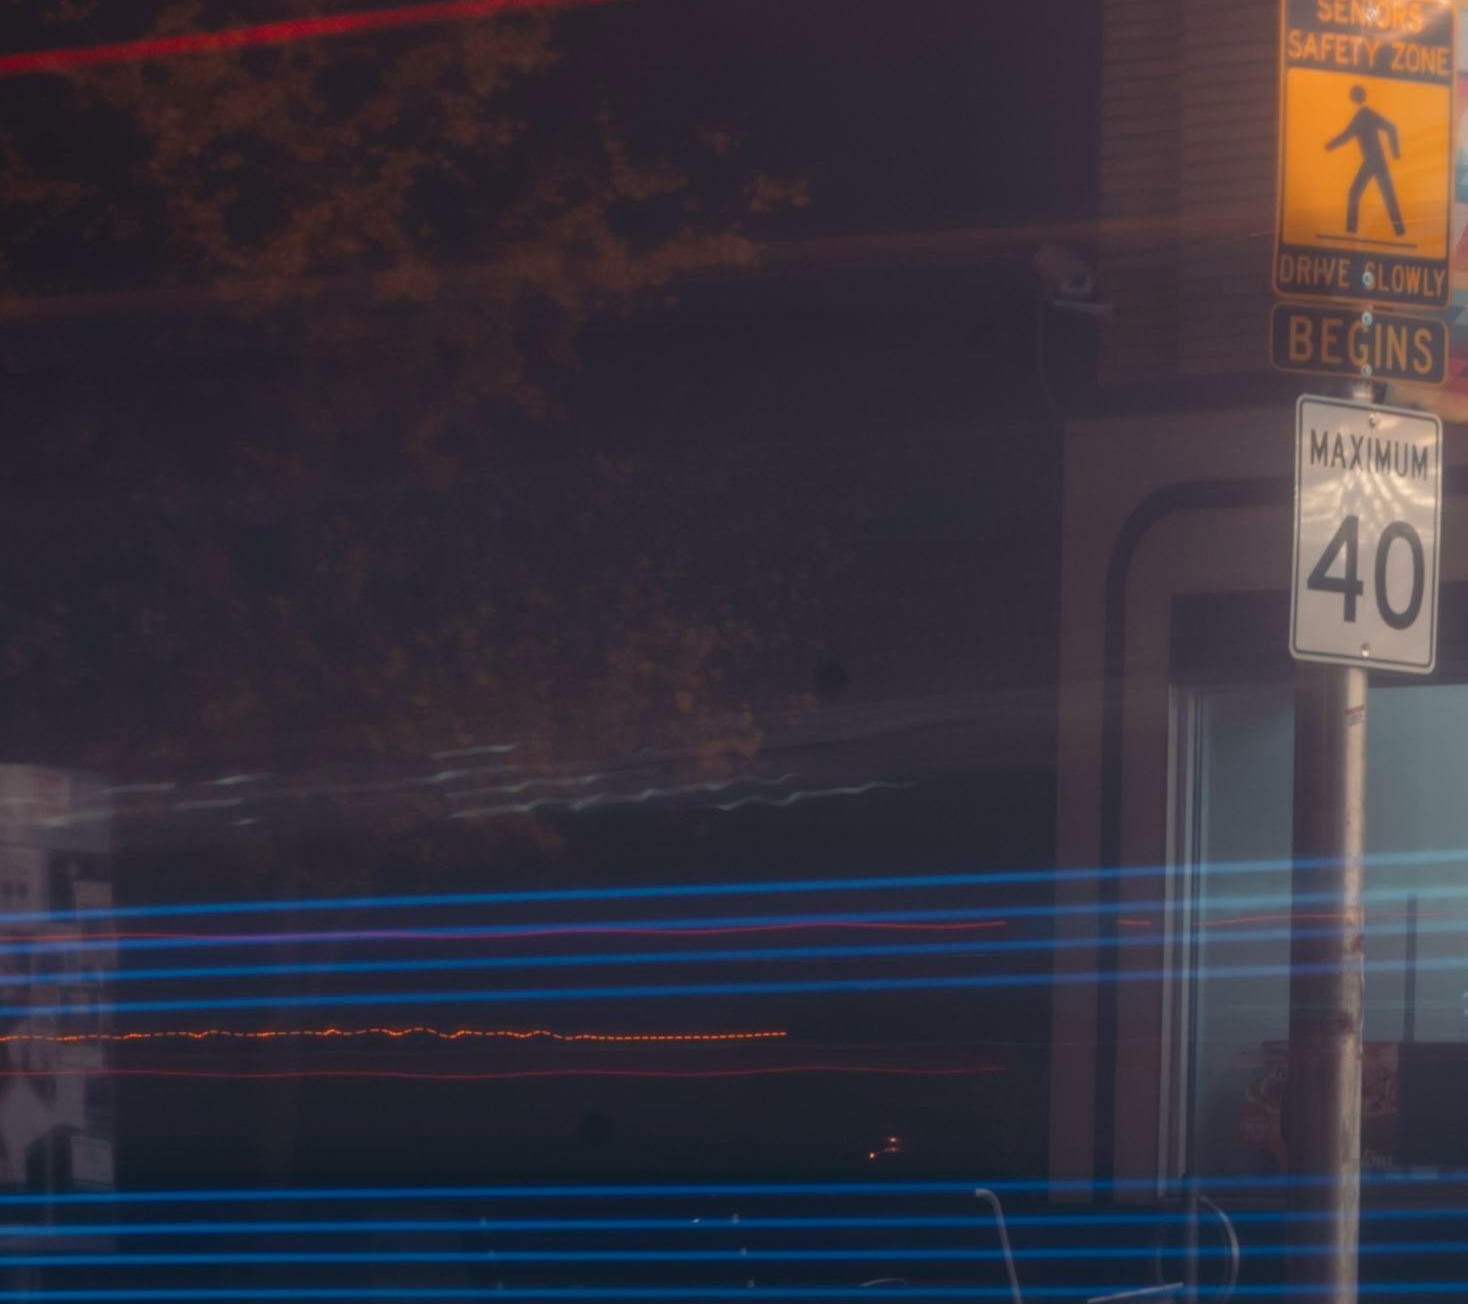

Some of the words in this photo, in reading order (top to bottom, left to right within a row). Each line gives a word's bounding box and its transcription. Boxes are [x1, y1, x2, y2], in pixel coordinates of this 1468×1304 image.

[1288, 29, 1380, 68] SAFETY
[1391, 41, 1448, 76] ZONE
[1280, 253, 1350, 289] DRIVE
[1364, 260, 1446, 297] SLOWLY
[1288, 314, 1433, 375] BEGINS
[1310, 428, 1428, 480] MAXIMUM
[1306, 514, 1425, 631] 40
